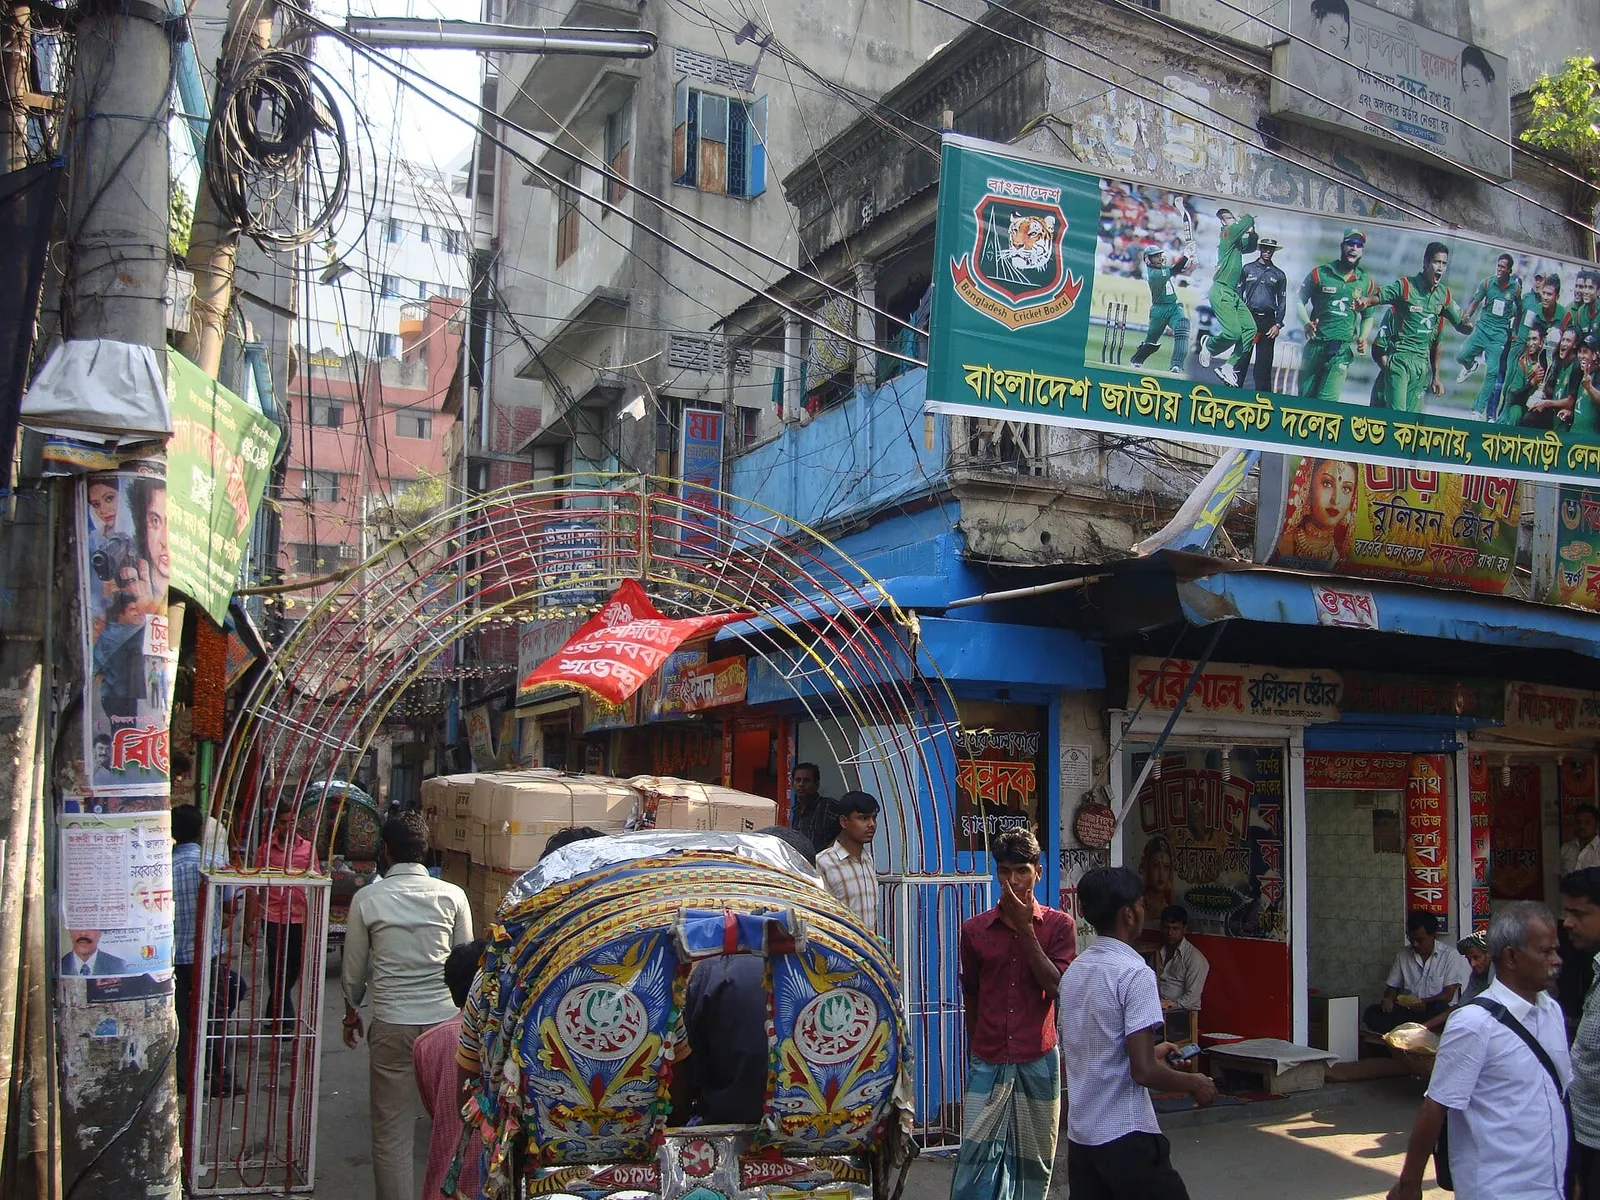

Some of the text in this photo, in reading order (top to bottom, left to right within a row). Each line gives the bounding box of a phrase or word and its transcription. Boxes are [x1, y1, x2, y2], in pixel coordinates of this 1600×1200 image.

[988, 178, 1060, 202] বাংলাদেশ
[960, 281, 1069, 323] Bangladesh Cricket Board
[962, 363, 1093, 412] বাংলাদেশ
[1098, 377, 1182, 423] জাতীয়
[1189, 384, 1275, 432] ক্রিকেট
[1280, 406, 1344, 443] দলের
[1350, 415, 1387, 444] শুভ
[1393, 421, 1473, 465] কামনায়,
[1481, 430, 1563, 472] বাসাবাড়ী
[1372, 495, 1445, 536] বুলিয়ন
[1354, 535, 1509, 574] স্বর্ণের অলংকার বন্ধক রাখা হয়
[1318, 588, 1371, 620] ঔষধ
[1248, 672, 1304, 708] বুলিয়ন
[1306, 756, 1330, 767] নাথ
[1335, 757, 1368, 768] গোল্ড
[956, 758, 1036, 806] বন্ধক
[1409, 776, 1442, 795] নাথ
[1409, 814, 1442, 828] হাউজ
[1410, 797, 1440, 810] গোল্ড
[1255, 803, 1283, 907] বন্ধক
[1411, 830, 1440, 844] স্বর্ণ
[1410, 846, 1444, 904] বন্ধক
